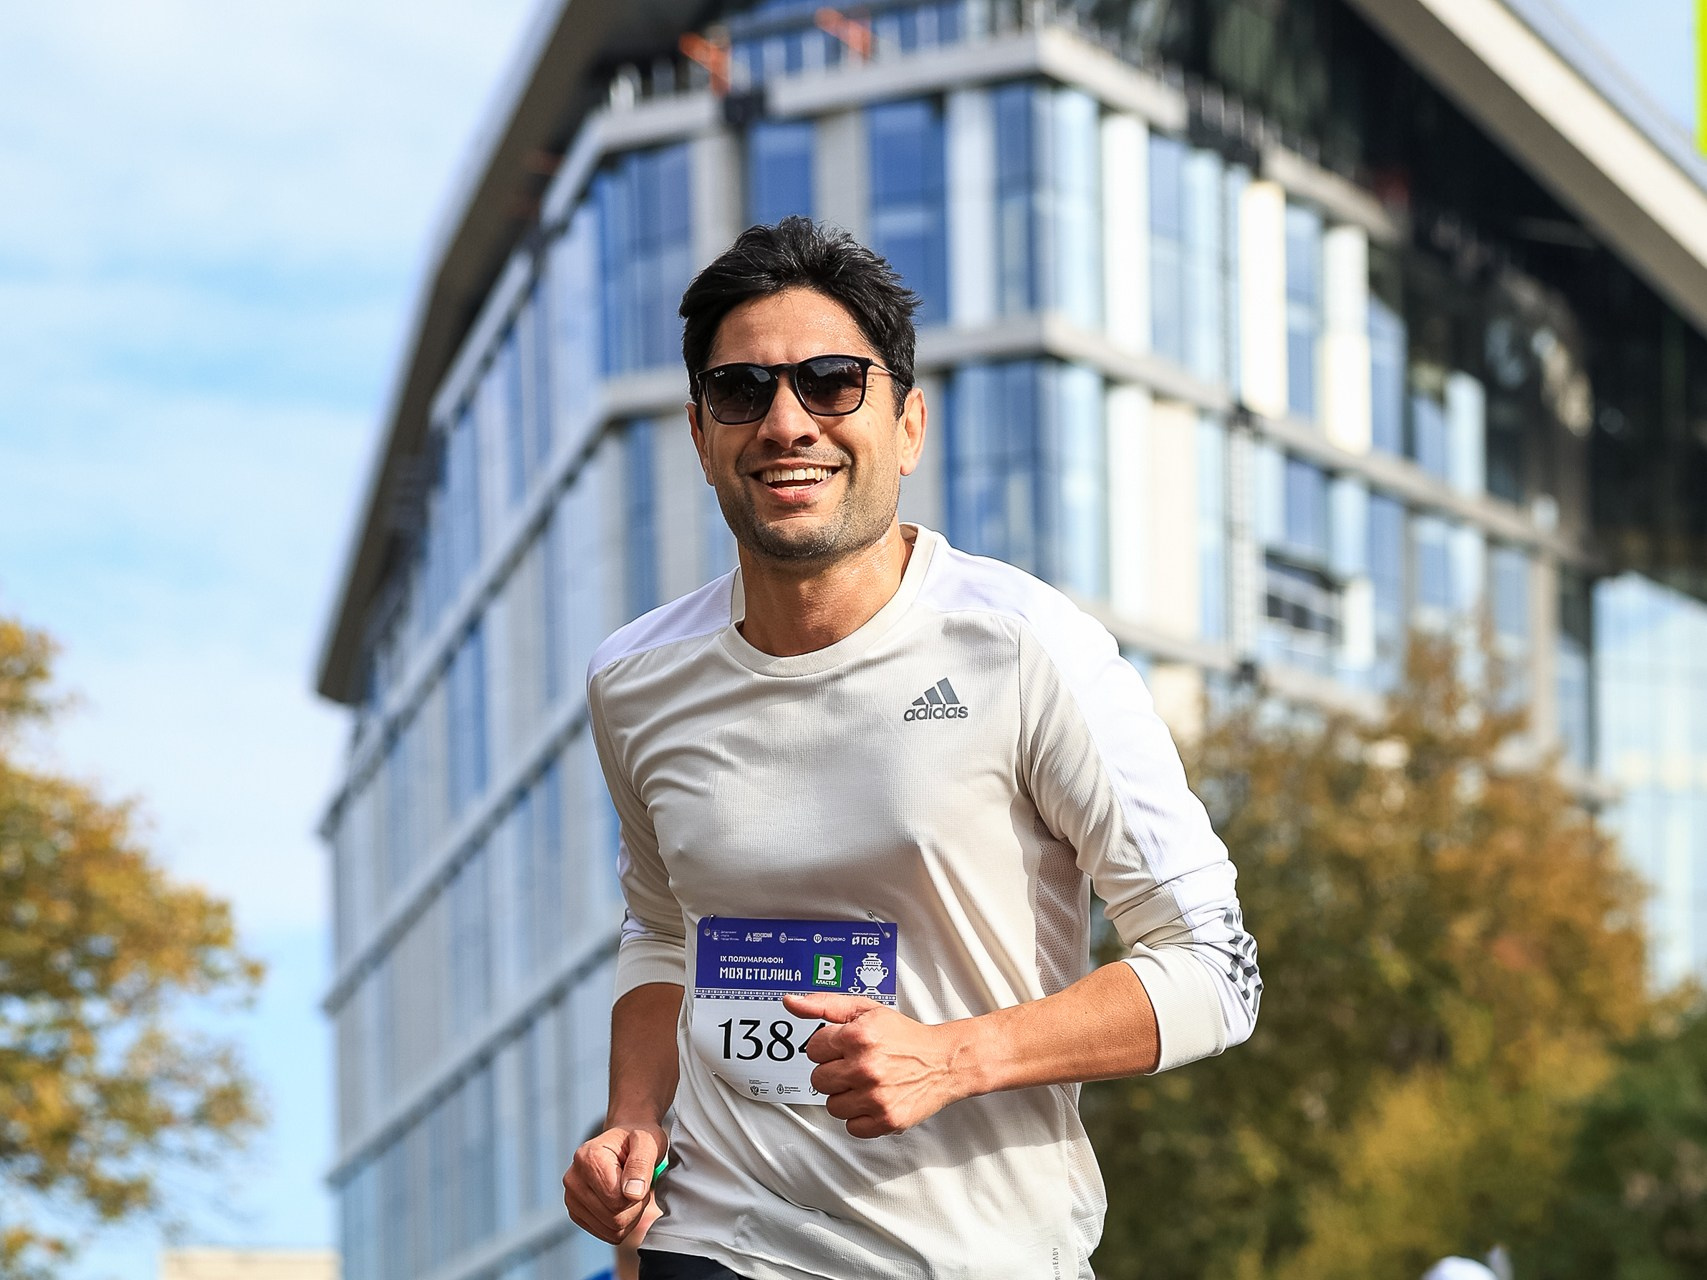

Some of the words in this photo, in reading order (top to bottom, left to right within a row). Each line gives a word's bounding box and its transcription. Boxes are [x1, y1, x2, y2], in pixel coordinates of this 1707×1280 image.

[903, 704, 969, 722] adidas
[861, 936, 880, 946] ПСБ
[728, 956, 784, 964] ПОЛУМАРАФОН
[720, 967, 743, 980] МОЯ
[745, 968, 802, 982] СТОЛИЦА
